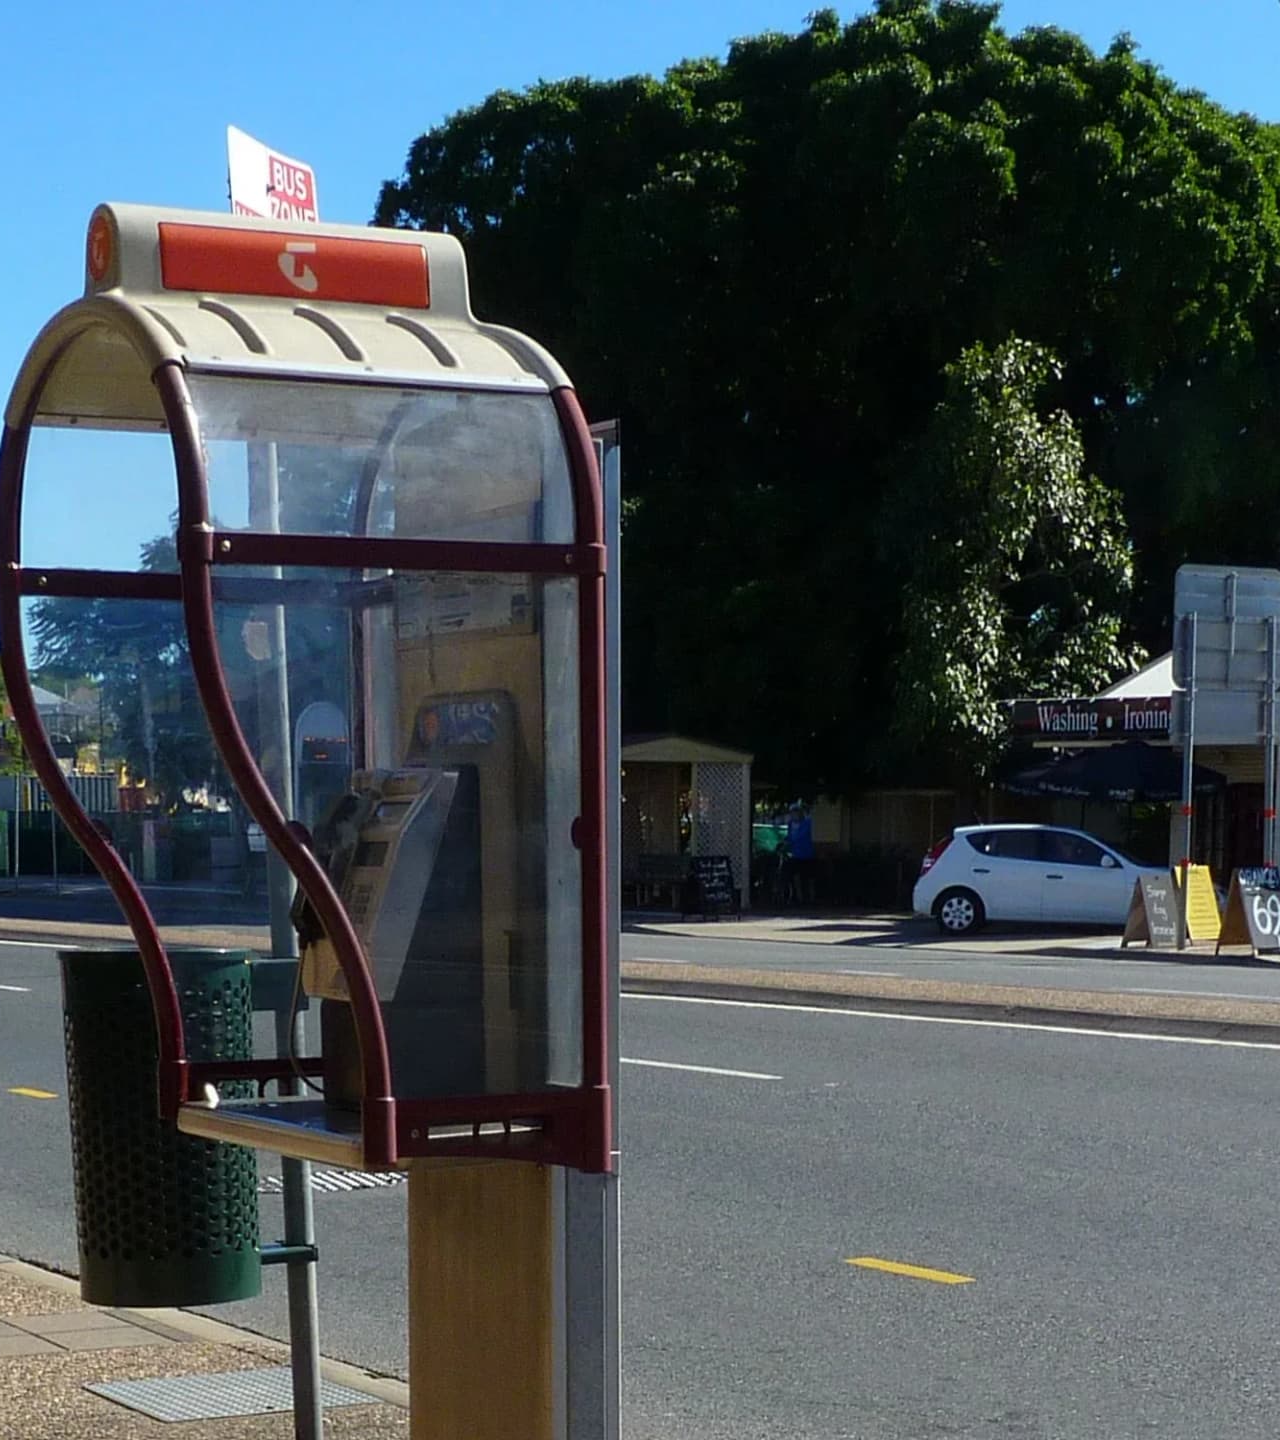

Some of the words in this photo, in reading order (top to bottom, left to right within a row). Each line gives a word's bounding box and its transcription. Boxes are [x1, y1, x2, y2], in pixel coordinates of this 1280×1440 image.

[272, 160, 308, 201] BUS
[1037, 704, 1099, 736] Washing
[1124, 703, 1172, 736] Ironin
